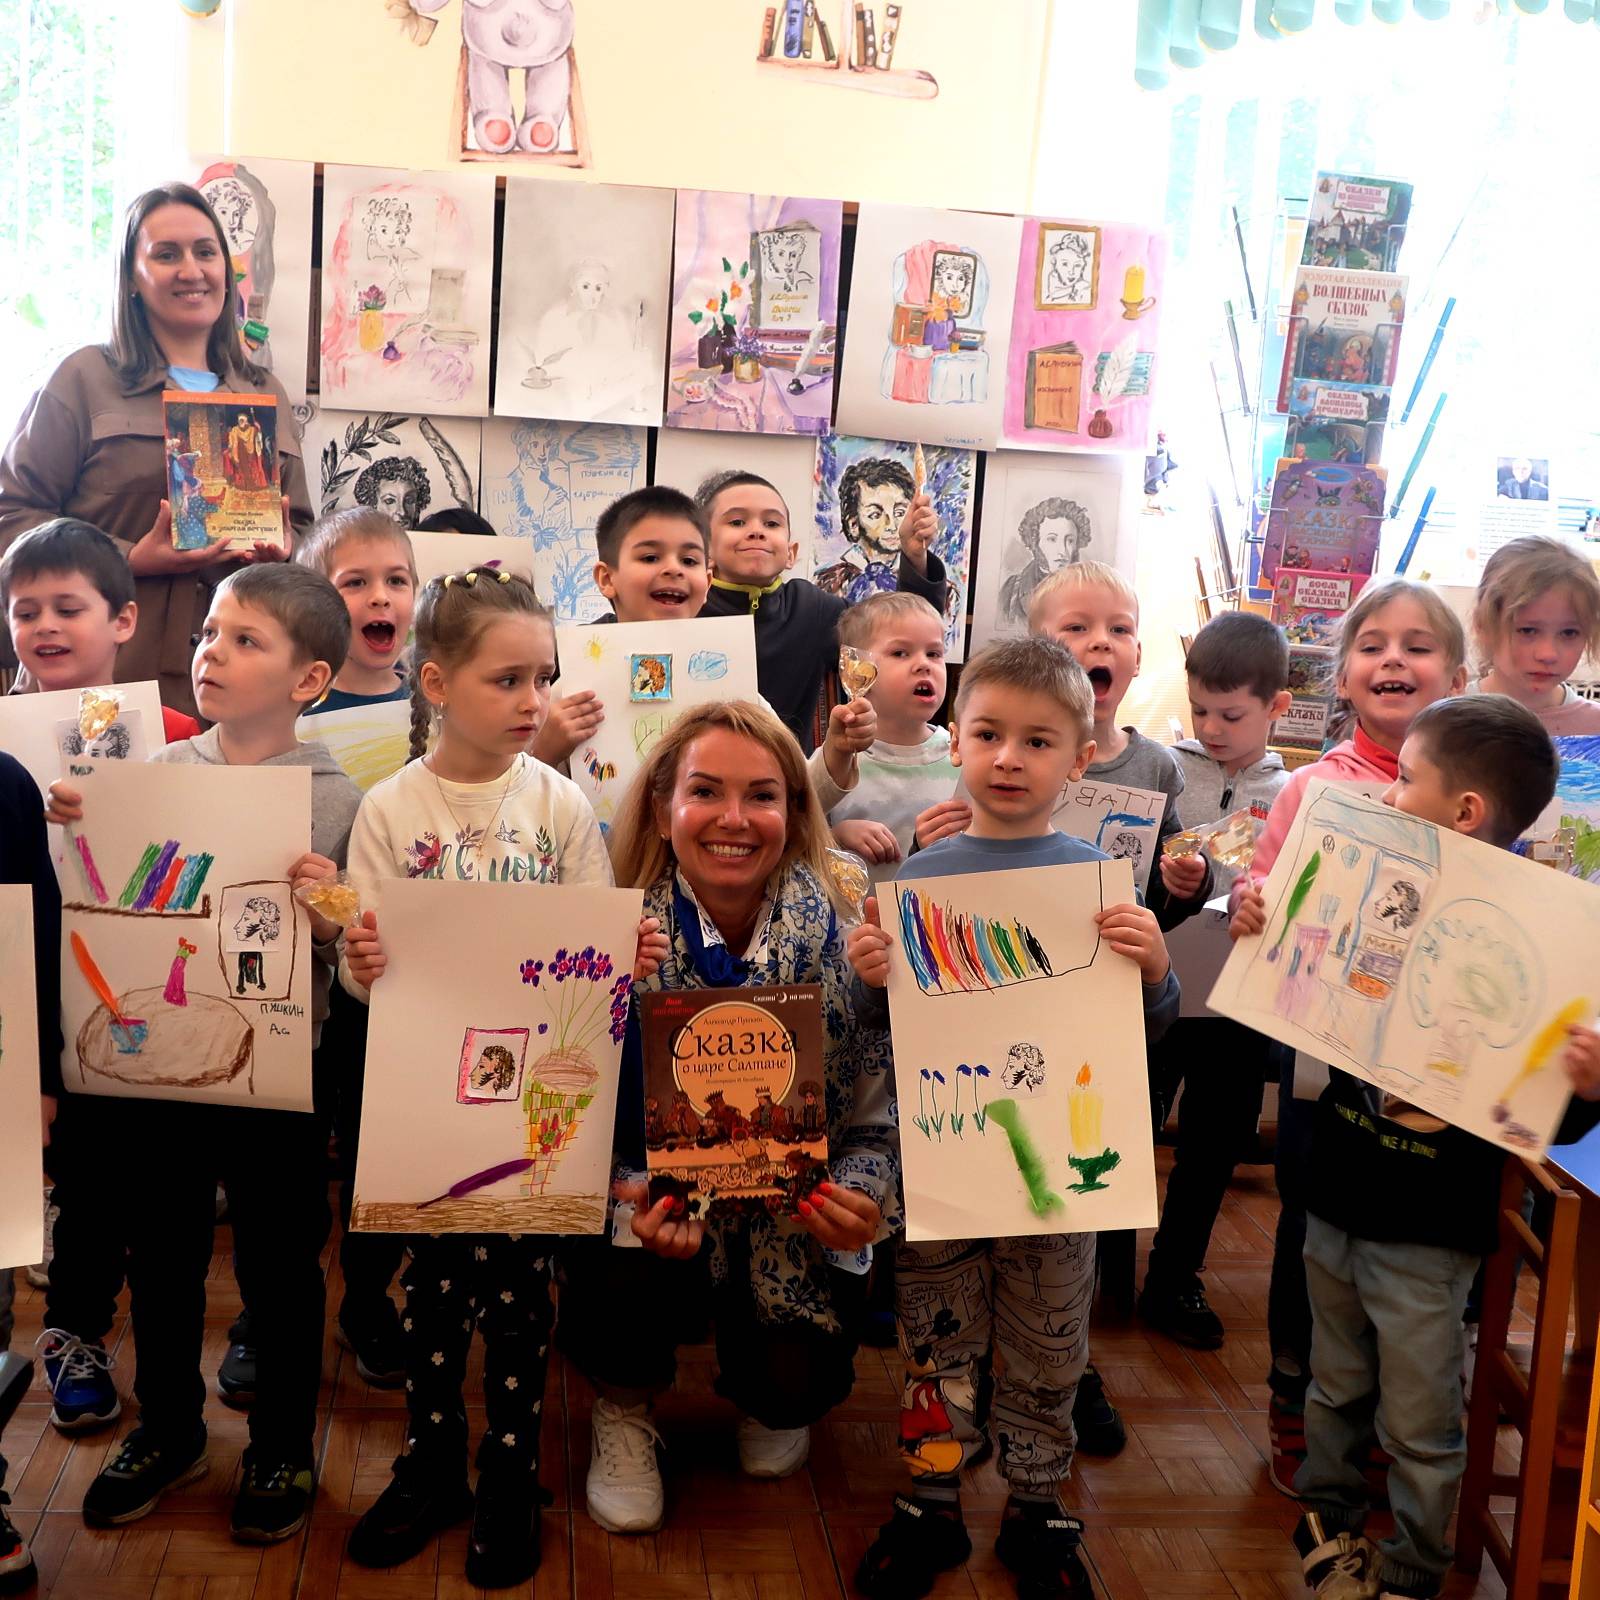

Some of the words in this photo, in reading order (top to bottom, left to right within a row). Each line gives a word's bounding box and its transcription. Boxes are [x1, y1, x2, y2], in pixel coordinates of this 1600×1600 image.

[1312, 284, 1387, 303] ВОЛШЕБНЫХ
[1327, 301, 1370, 317] СКАЗОК
[1301, 596, 1341, 606] СКАЗКИ
[260, 1003, 304, 1018] ПУШКИН
[703, 1017, 736, 1026] Александр
[737, 1016, 763, 1025] Пушкин
[668, 1024, 801, 1060] Сказка
[682, 1066, 690, 1074] о
[693, 1062, 724, 1077] царе
[727, 1057, 787, 1073] Салтане
